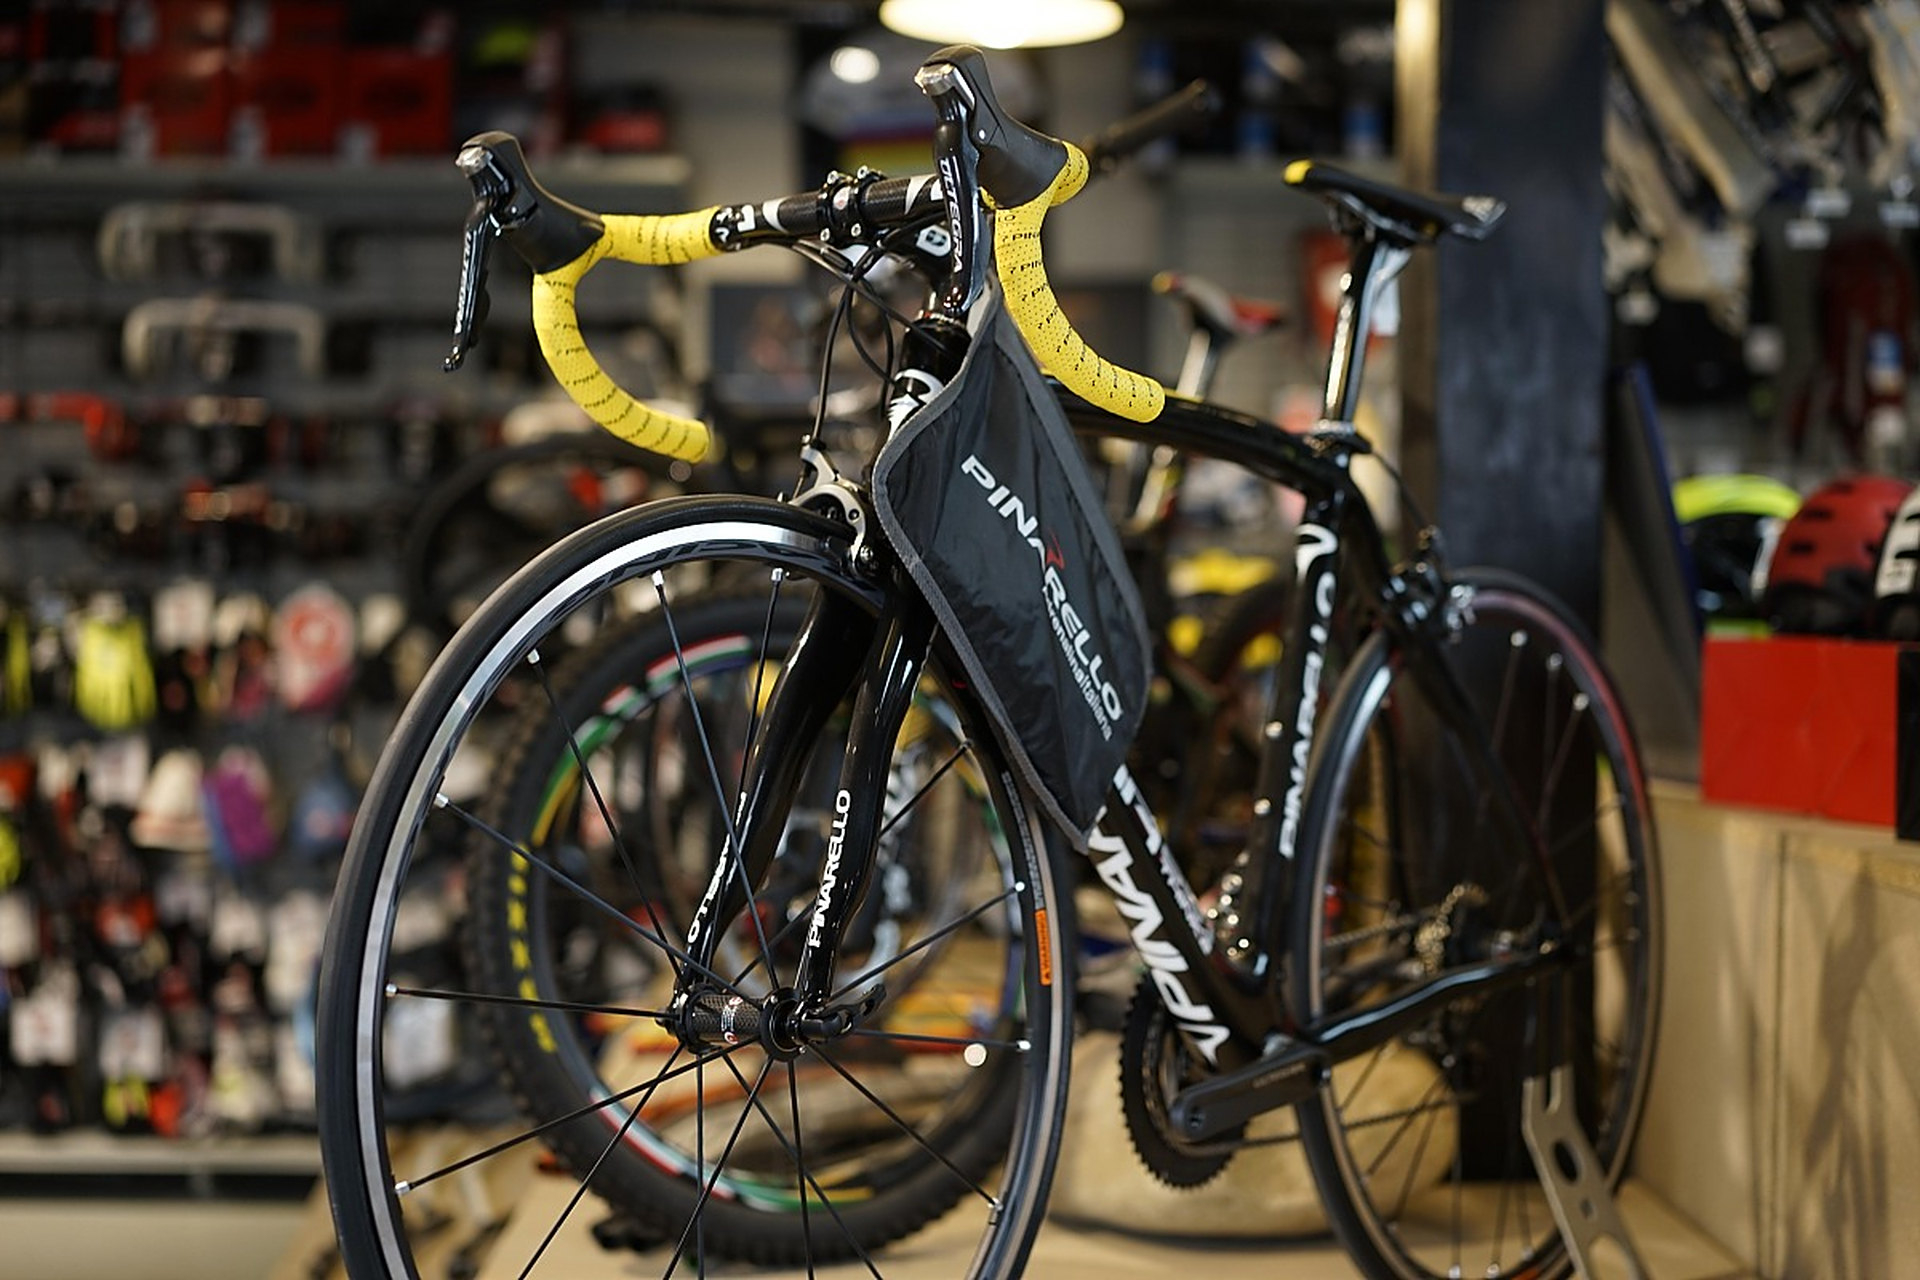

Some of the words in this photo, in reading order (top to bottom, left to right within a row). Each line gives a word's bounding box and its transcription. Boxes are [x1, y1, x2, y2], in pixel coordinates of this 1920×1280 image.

[938, 157, 964, 273] ULTEGRA
[961, 454, 1123, 721] PINARELLO
[808, 789, 851, 948] PINARELLO
